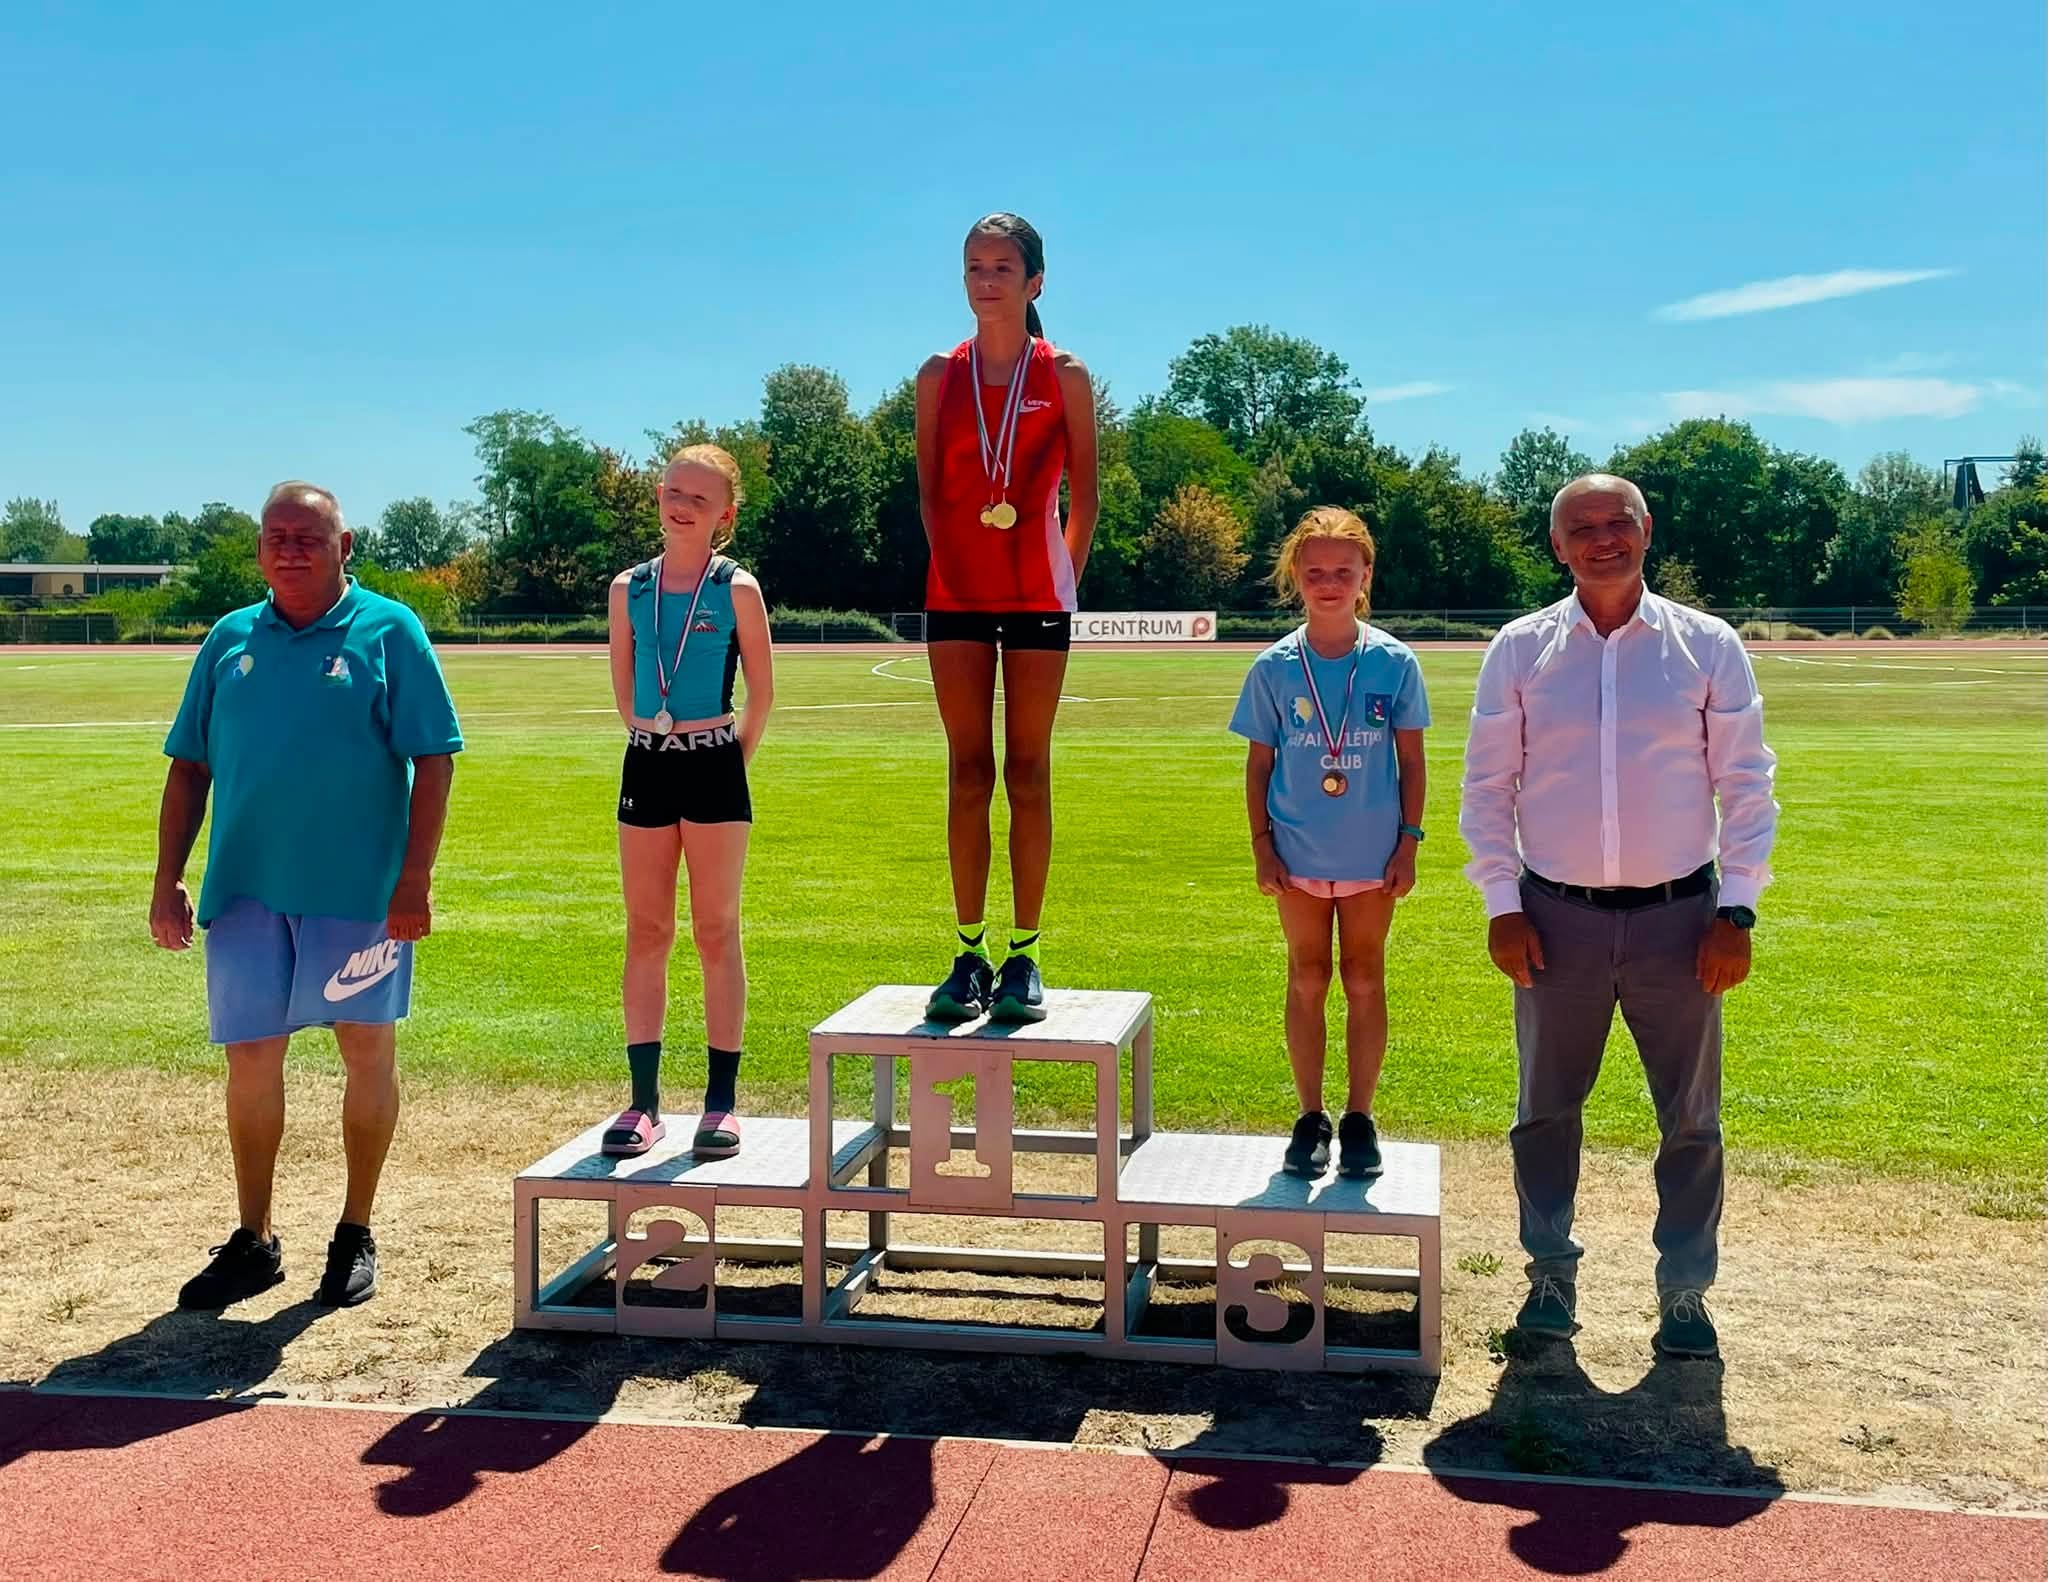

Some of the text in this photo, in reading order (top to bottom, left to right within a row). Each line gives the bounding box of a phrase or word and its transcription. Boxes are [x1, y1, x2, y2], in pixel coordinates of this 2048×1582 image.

[1088, 620, 1183, 636] CENTRUM
[931, 1072, 992, 1178] 1
[623, 1205, 710, 1310] 2
[1224, 1239, 1315, 1344] 3
